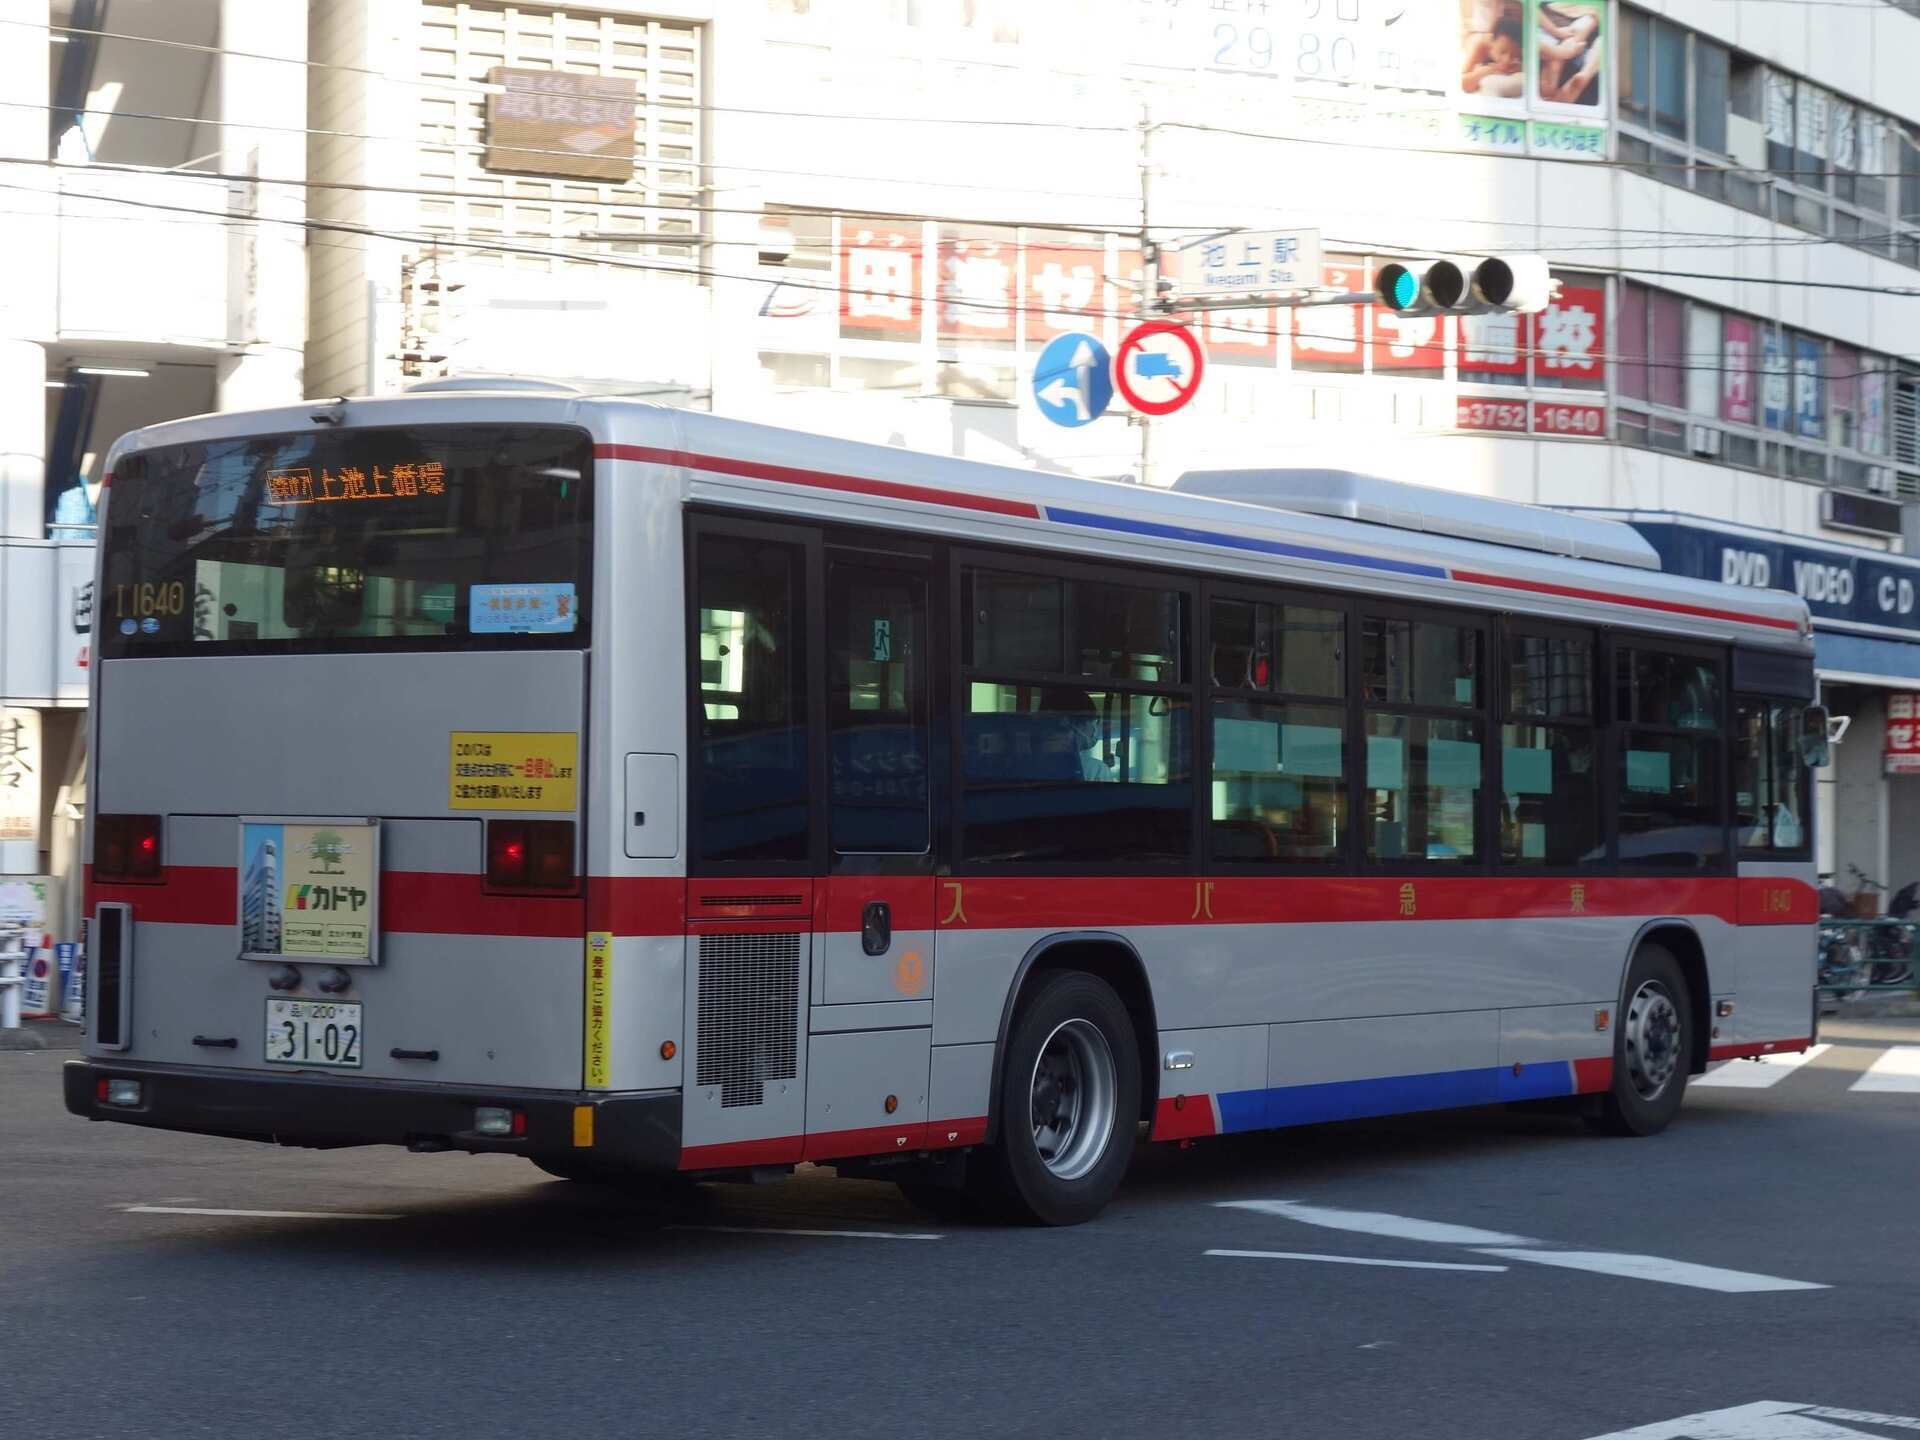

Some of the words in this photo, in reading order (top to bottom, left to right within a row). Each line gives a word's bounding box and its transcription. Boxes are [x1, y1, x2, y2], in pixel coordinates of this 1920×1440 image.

[1464, 123, 1520, 145] オイル
[1201, 238, 1298, 269] 池上駅
[1205, 272, 1261, 286] Ikegami
[1470, 403, 1600, 433] 3752-1640
[1721, 547, 1771, 588] DVD
[1793, 559, 1855, 606] VIDEO
[311, 885, 368, 912] カドヤ
[311, 1005, 337, 1019] 200
